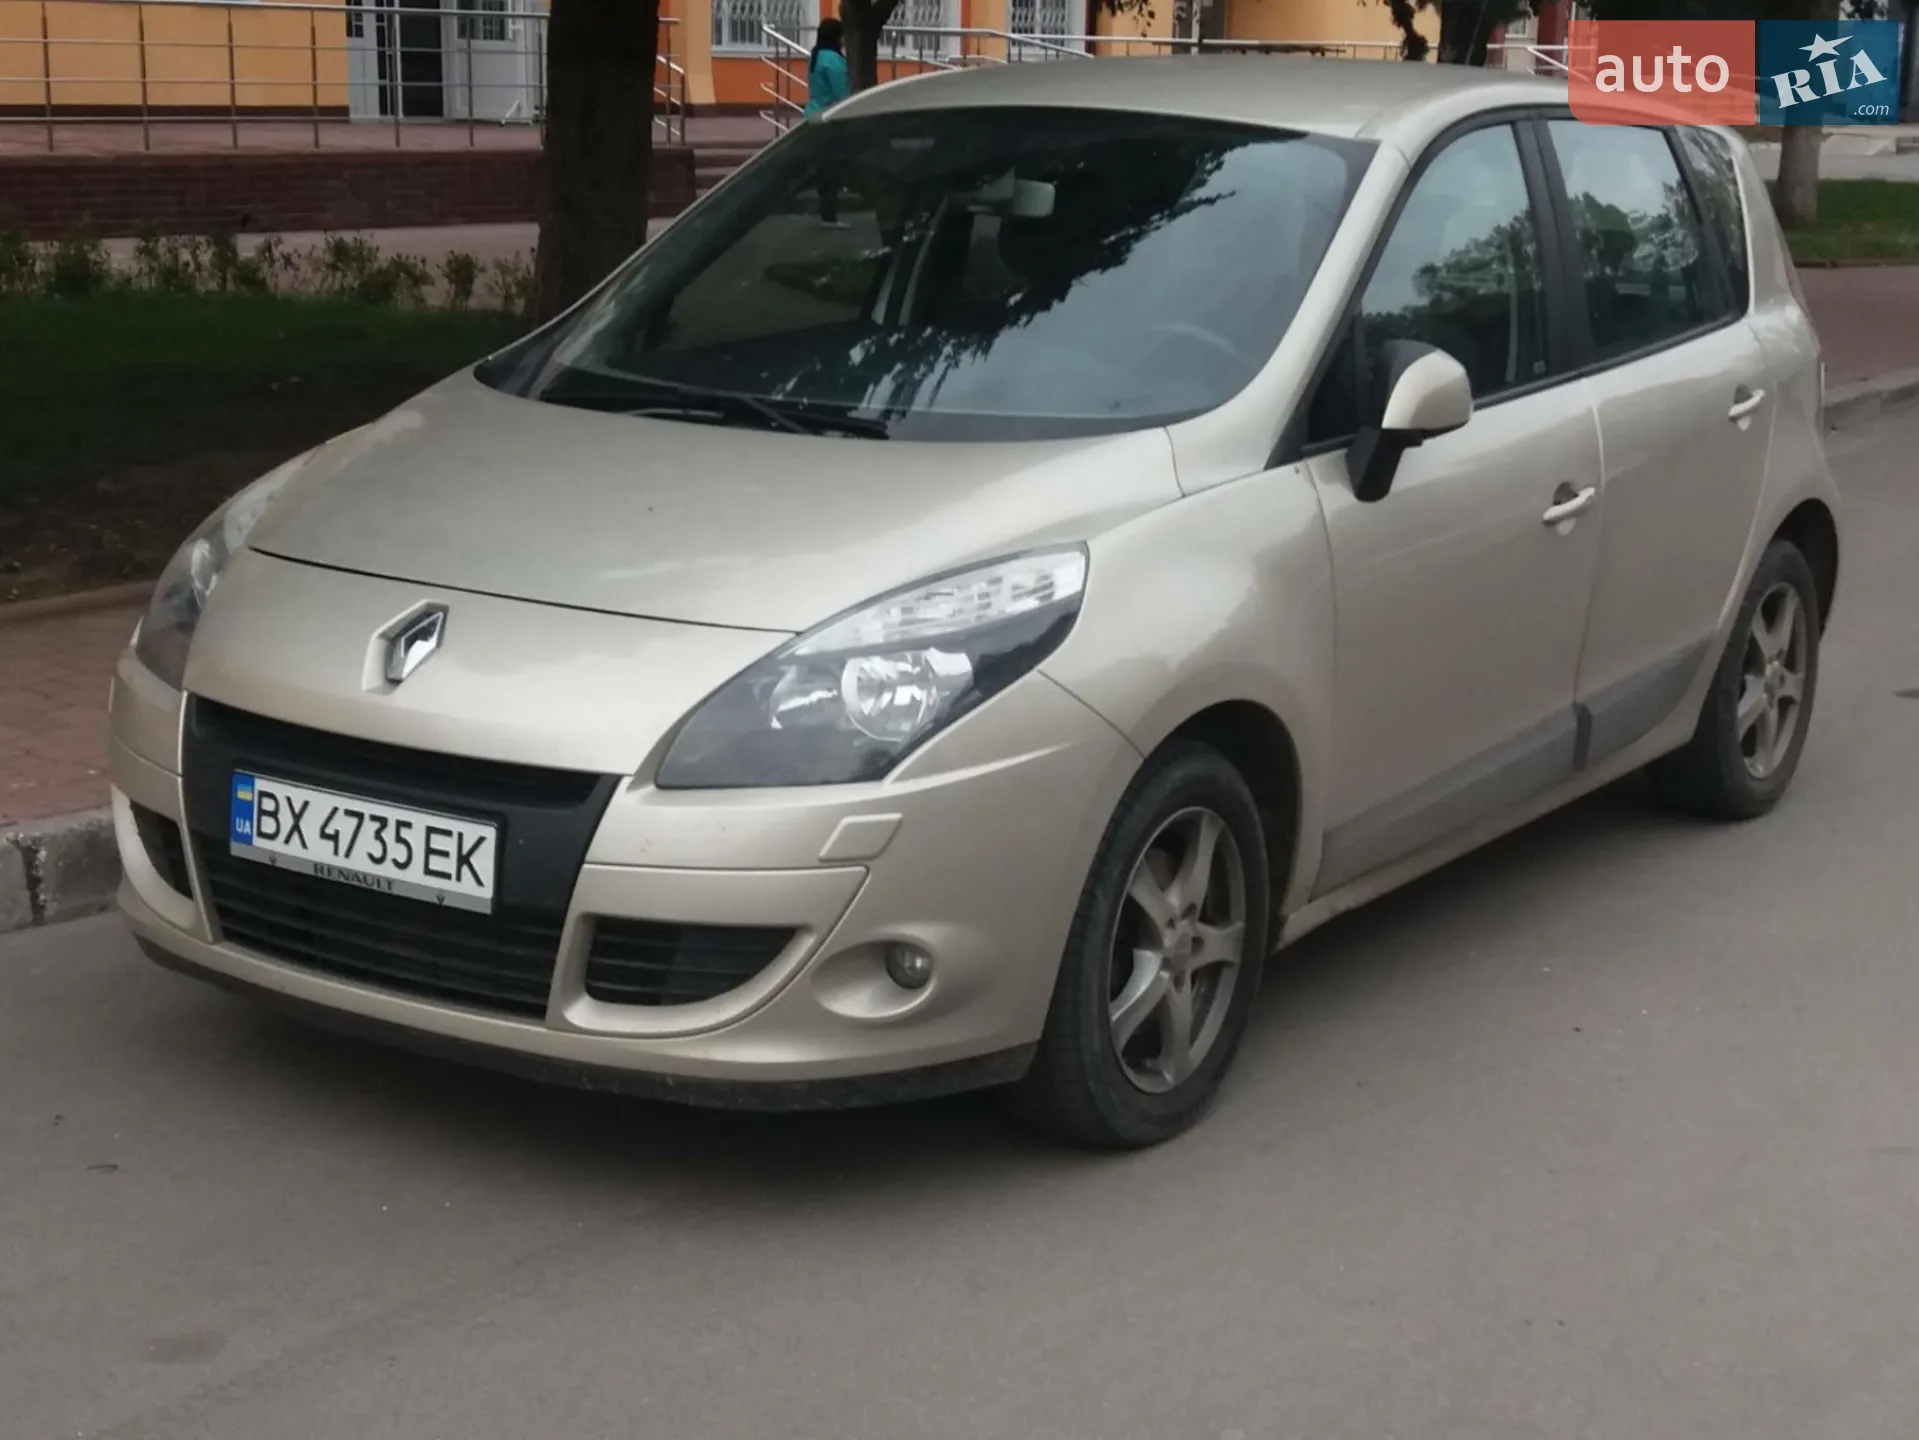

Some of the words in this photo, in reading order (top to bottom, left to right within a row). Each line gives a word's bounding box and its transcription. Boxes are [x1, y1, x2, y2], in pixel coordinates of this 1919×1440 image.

[235, 817, 251, 836] UA
[256, 789, 310, 850] BX
[319, 806, 414, 870] 4735
[423, 825, 487, 888] EK
[313, 863, 396, 892] RENAULT
